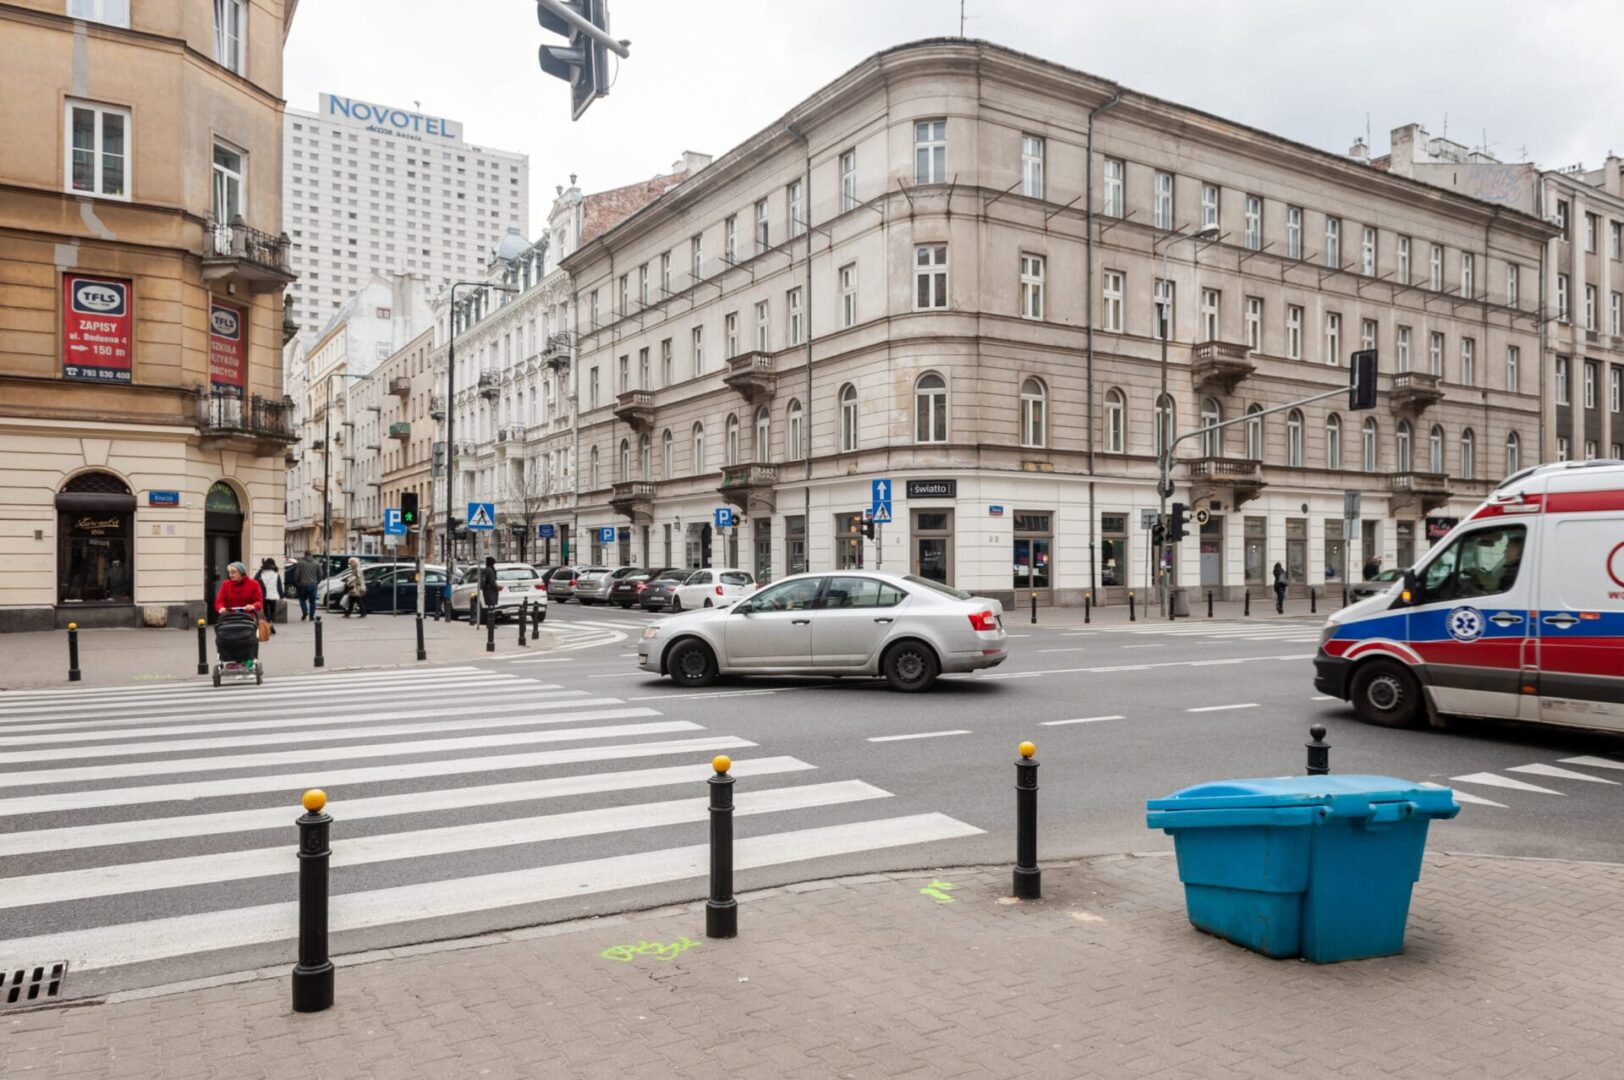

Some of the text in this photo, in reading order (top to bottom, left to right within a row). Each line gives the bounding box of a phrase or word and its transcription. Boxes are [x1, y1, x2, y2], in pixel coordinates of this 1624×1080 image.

[329, 94, 456, 139] NOVOTEL
[83, 292, 116, 303] TFLS
[79, 320, 117, 333] ZAPISY
[214, 315, 235, 328] TFLS
[93, 345, 126, 356] 150 m
[389, 510, 401, 527] P
[719, 510, 729, 524] P
[603, 528, 612, 540] P
